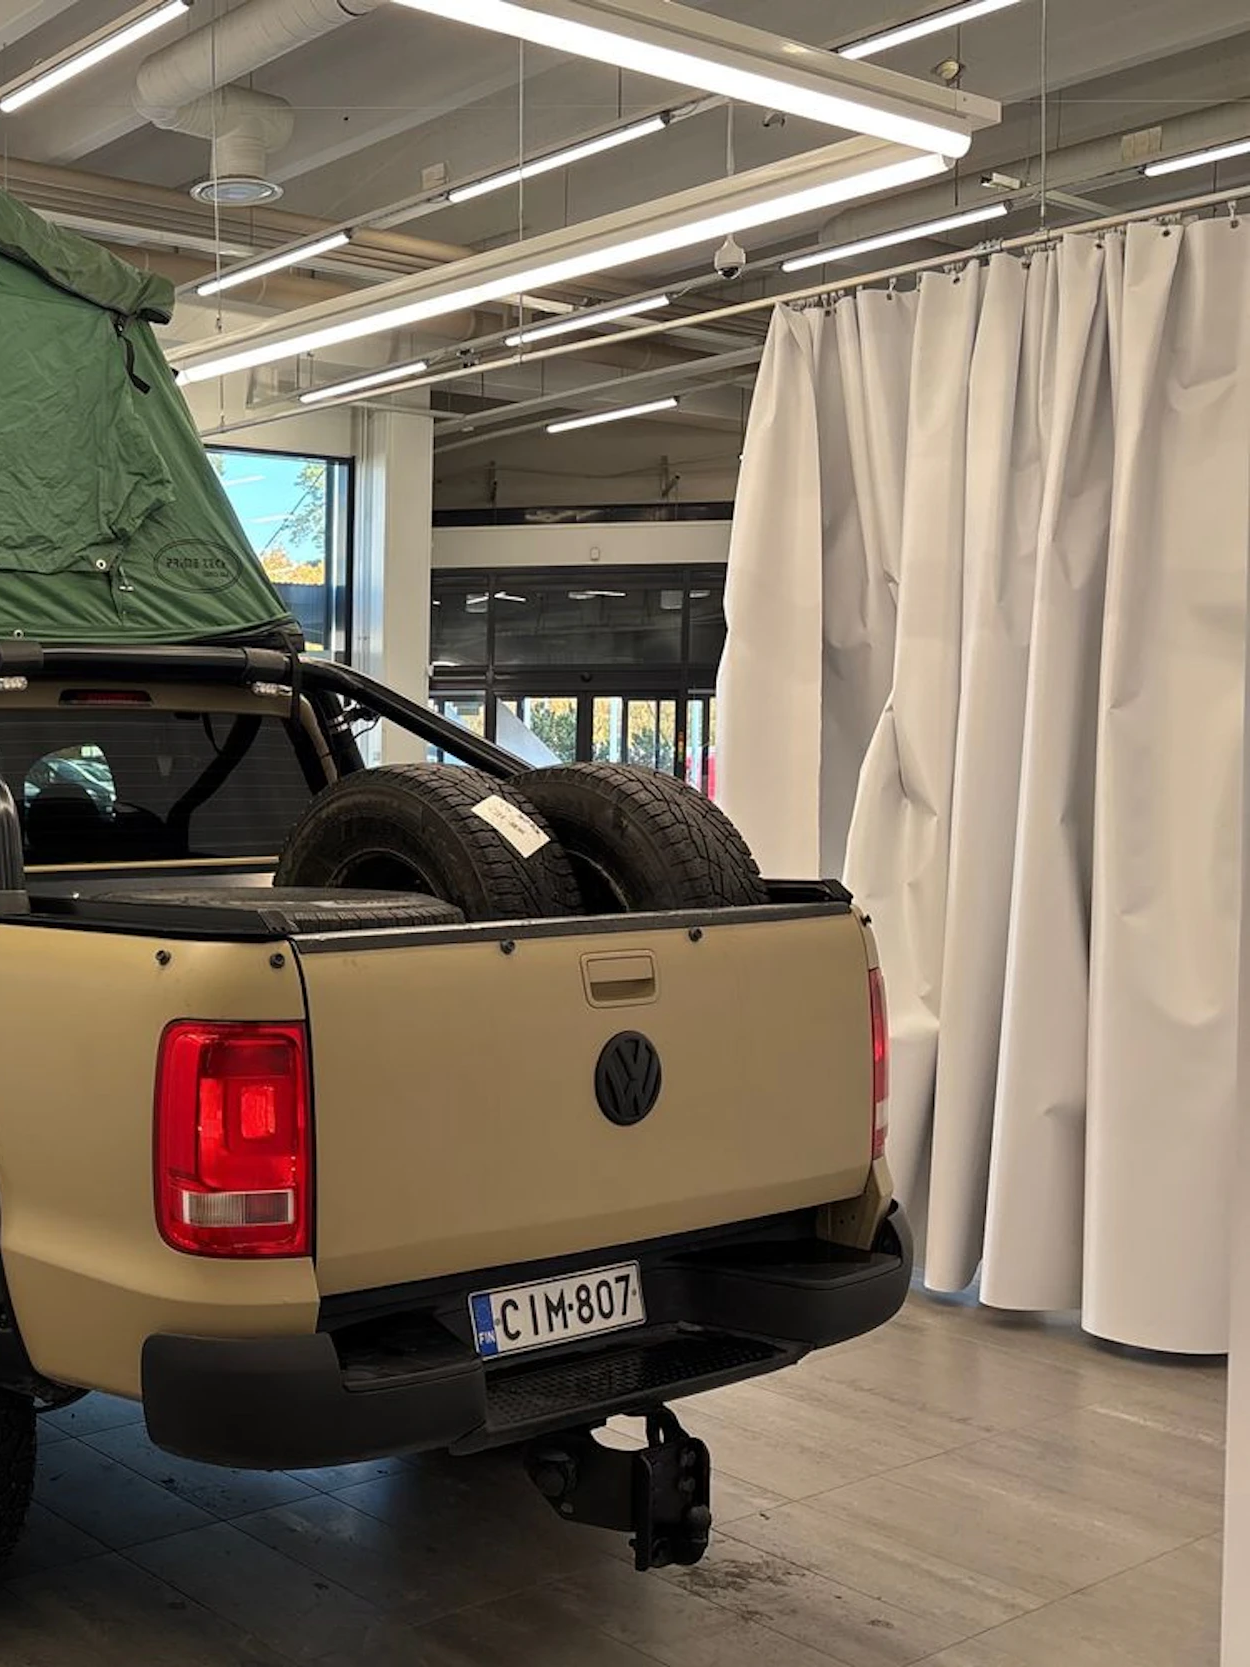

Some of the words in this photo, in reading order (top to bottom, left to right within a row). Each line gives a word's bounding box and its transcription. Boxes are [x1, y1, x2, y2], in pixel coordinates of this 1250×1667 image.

[598, 1034, 658, 1121] VW
[478, 1329, 496, 1344] FIN
[500, 1273, 631, 1341] CIM-807
